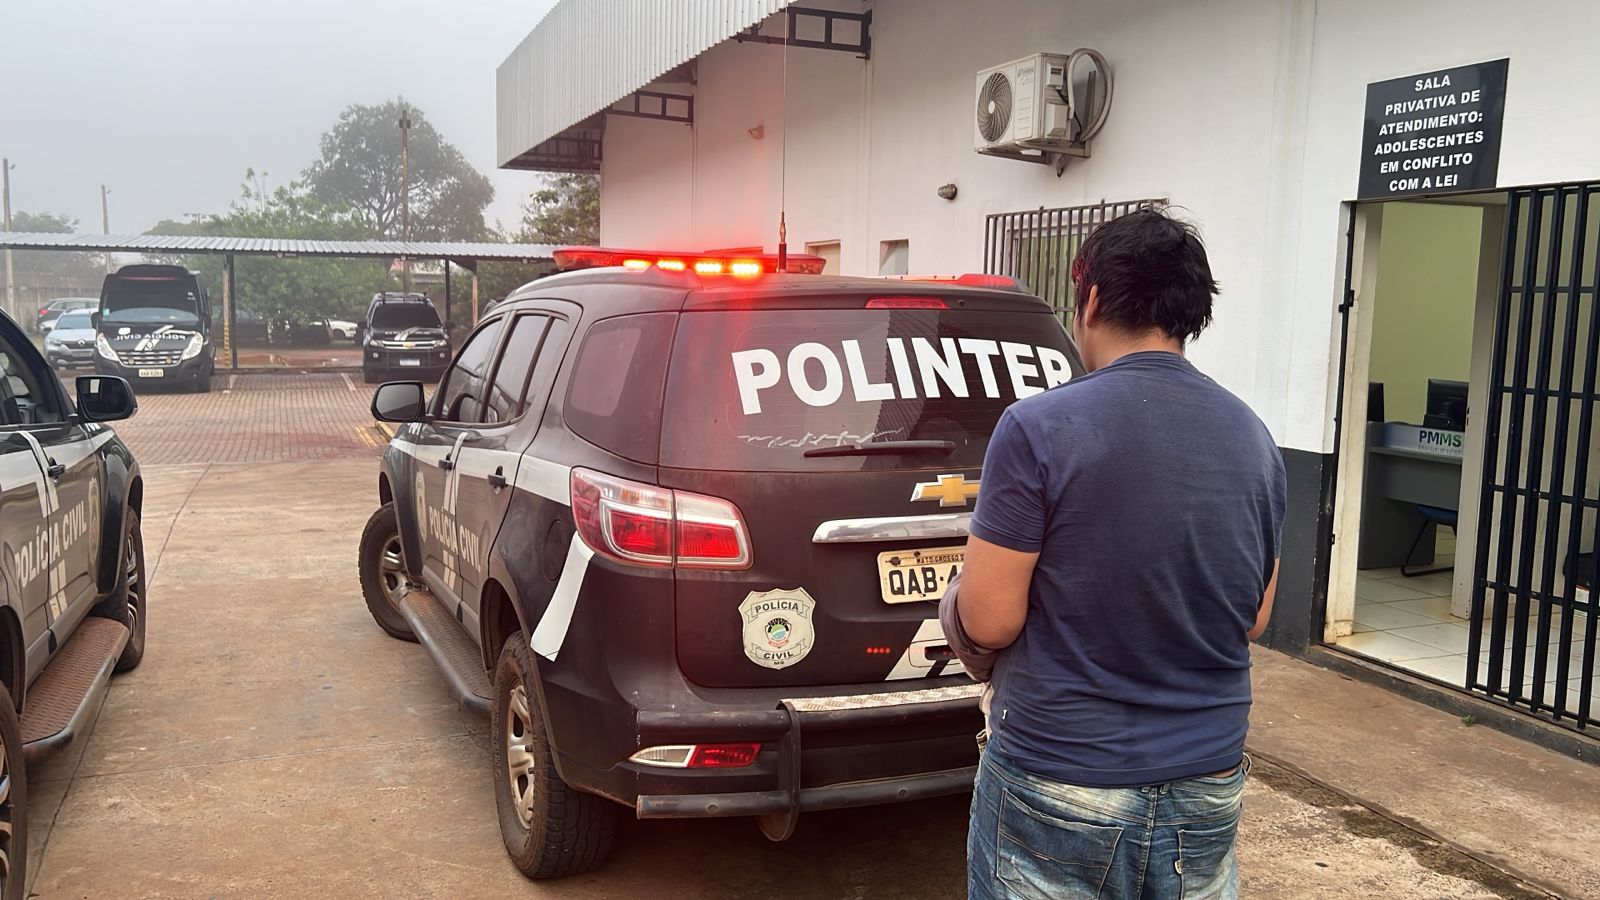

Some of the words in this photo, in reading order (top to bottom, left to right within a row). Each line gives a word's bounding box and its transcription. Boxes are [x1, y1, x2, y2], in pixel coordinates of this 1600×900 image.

[1415, 75, 1451, 92] SALA
[1385, 94, 1456, 116] PRIVATIVA
[1460, 89, 1481, 105] DE
[1378, 111, 1483, 136] ATENDIMENTO:
[1374, 130, 1484, 155] ADOLESCENTES
[1380, 161, 1399, 174] EM
[1402, 153, 1473, 171] CONFLITO
[1389, 178, 1418, 192] COM
[1422, 177, 1432, 189] A
[1435, 174, 1458, 188] LEI
[731, 337, 1073, 415] POLINTER
[1419, 430, 1462, 447] PMMS
[14, 523, 61, 588] POLÍCIA
[62, 500, 87, 551] CIVIL
[460, 524, 481, 573] CIVIL
[755, 600, 799, 613] POLÍCIA
[764, 651, 794, 660] CIVIL
